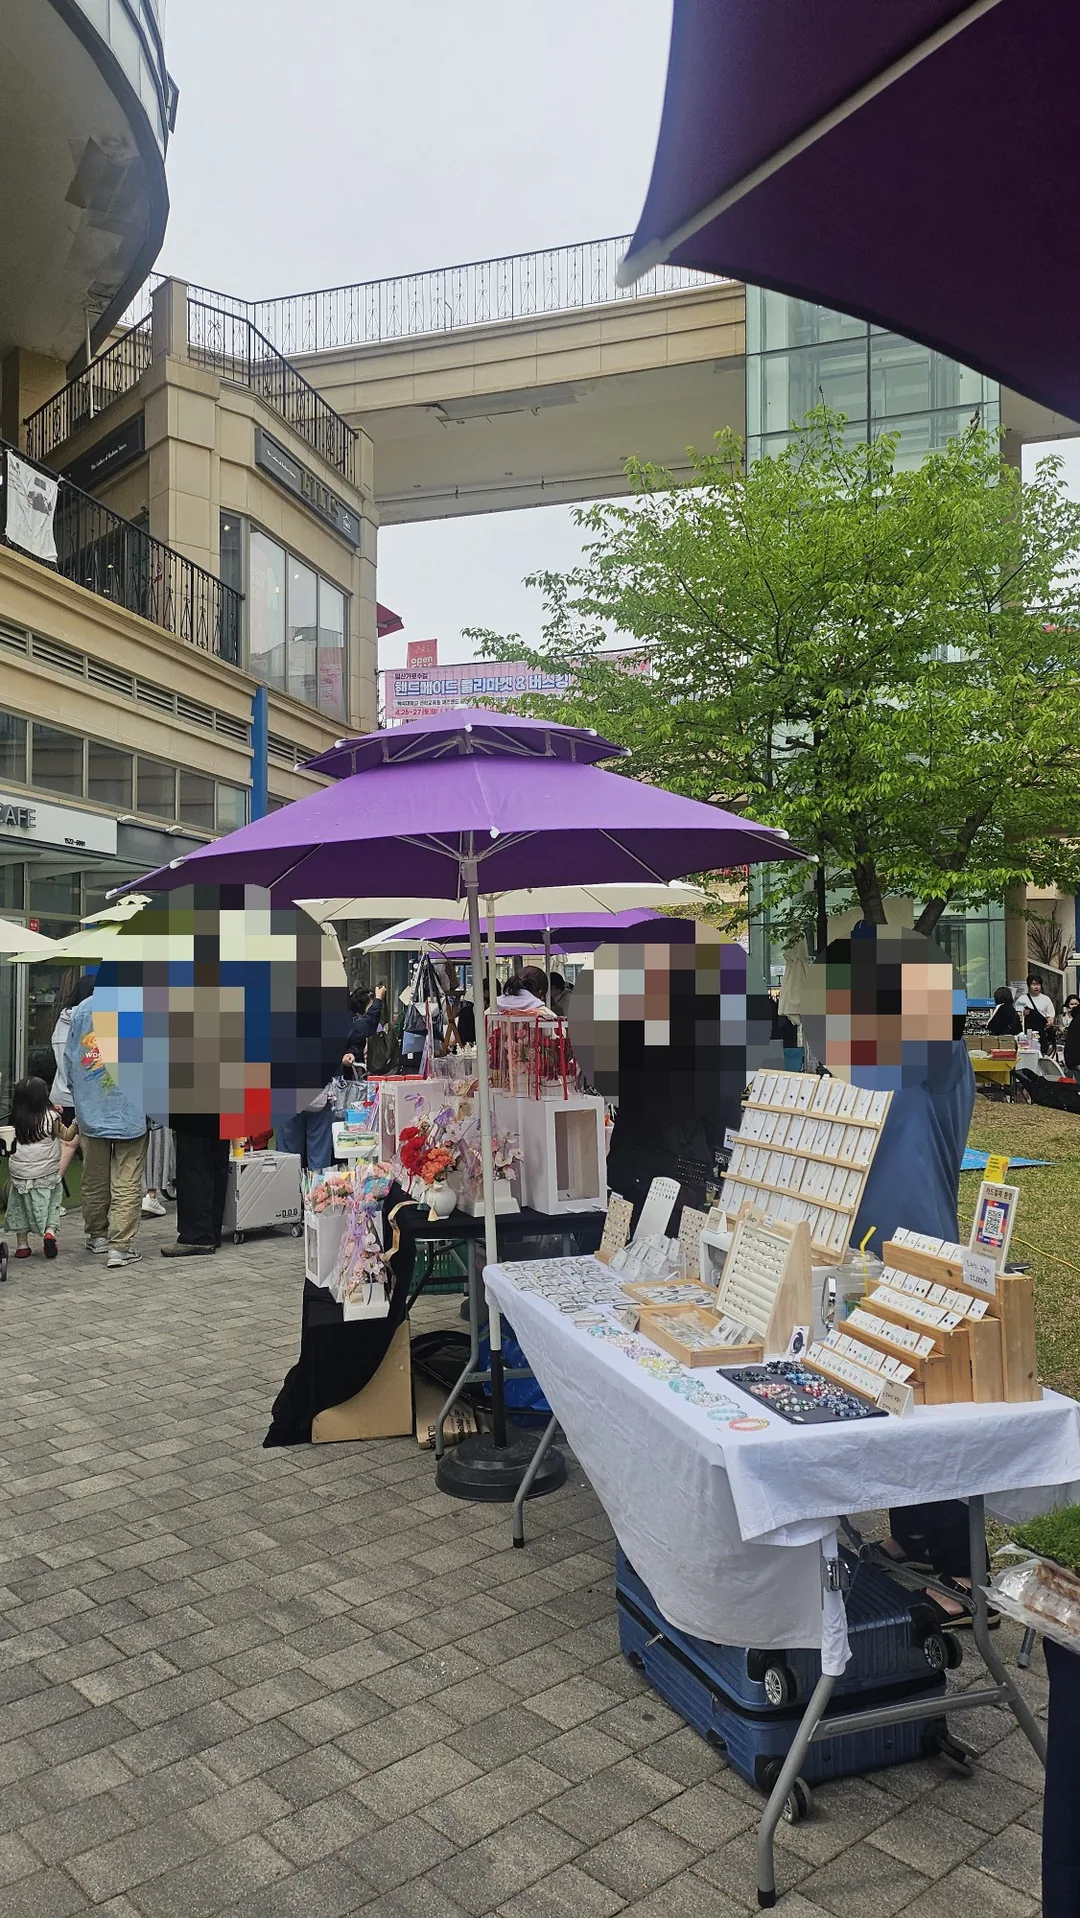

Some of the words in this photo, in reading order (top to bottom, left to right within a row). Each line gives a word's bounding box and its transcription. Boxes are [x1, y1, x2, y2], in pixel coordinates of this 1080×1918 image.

[394, 680, 458, 696] 핸드메이드
[461, 676, 513, 694] 플리마켓
[515, 675, 527, 690] &
[529, 673, 569, 690] 버스킹
